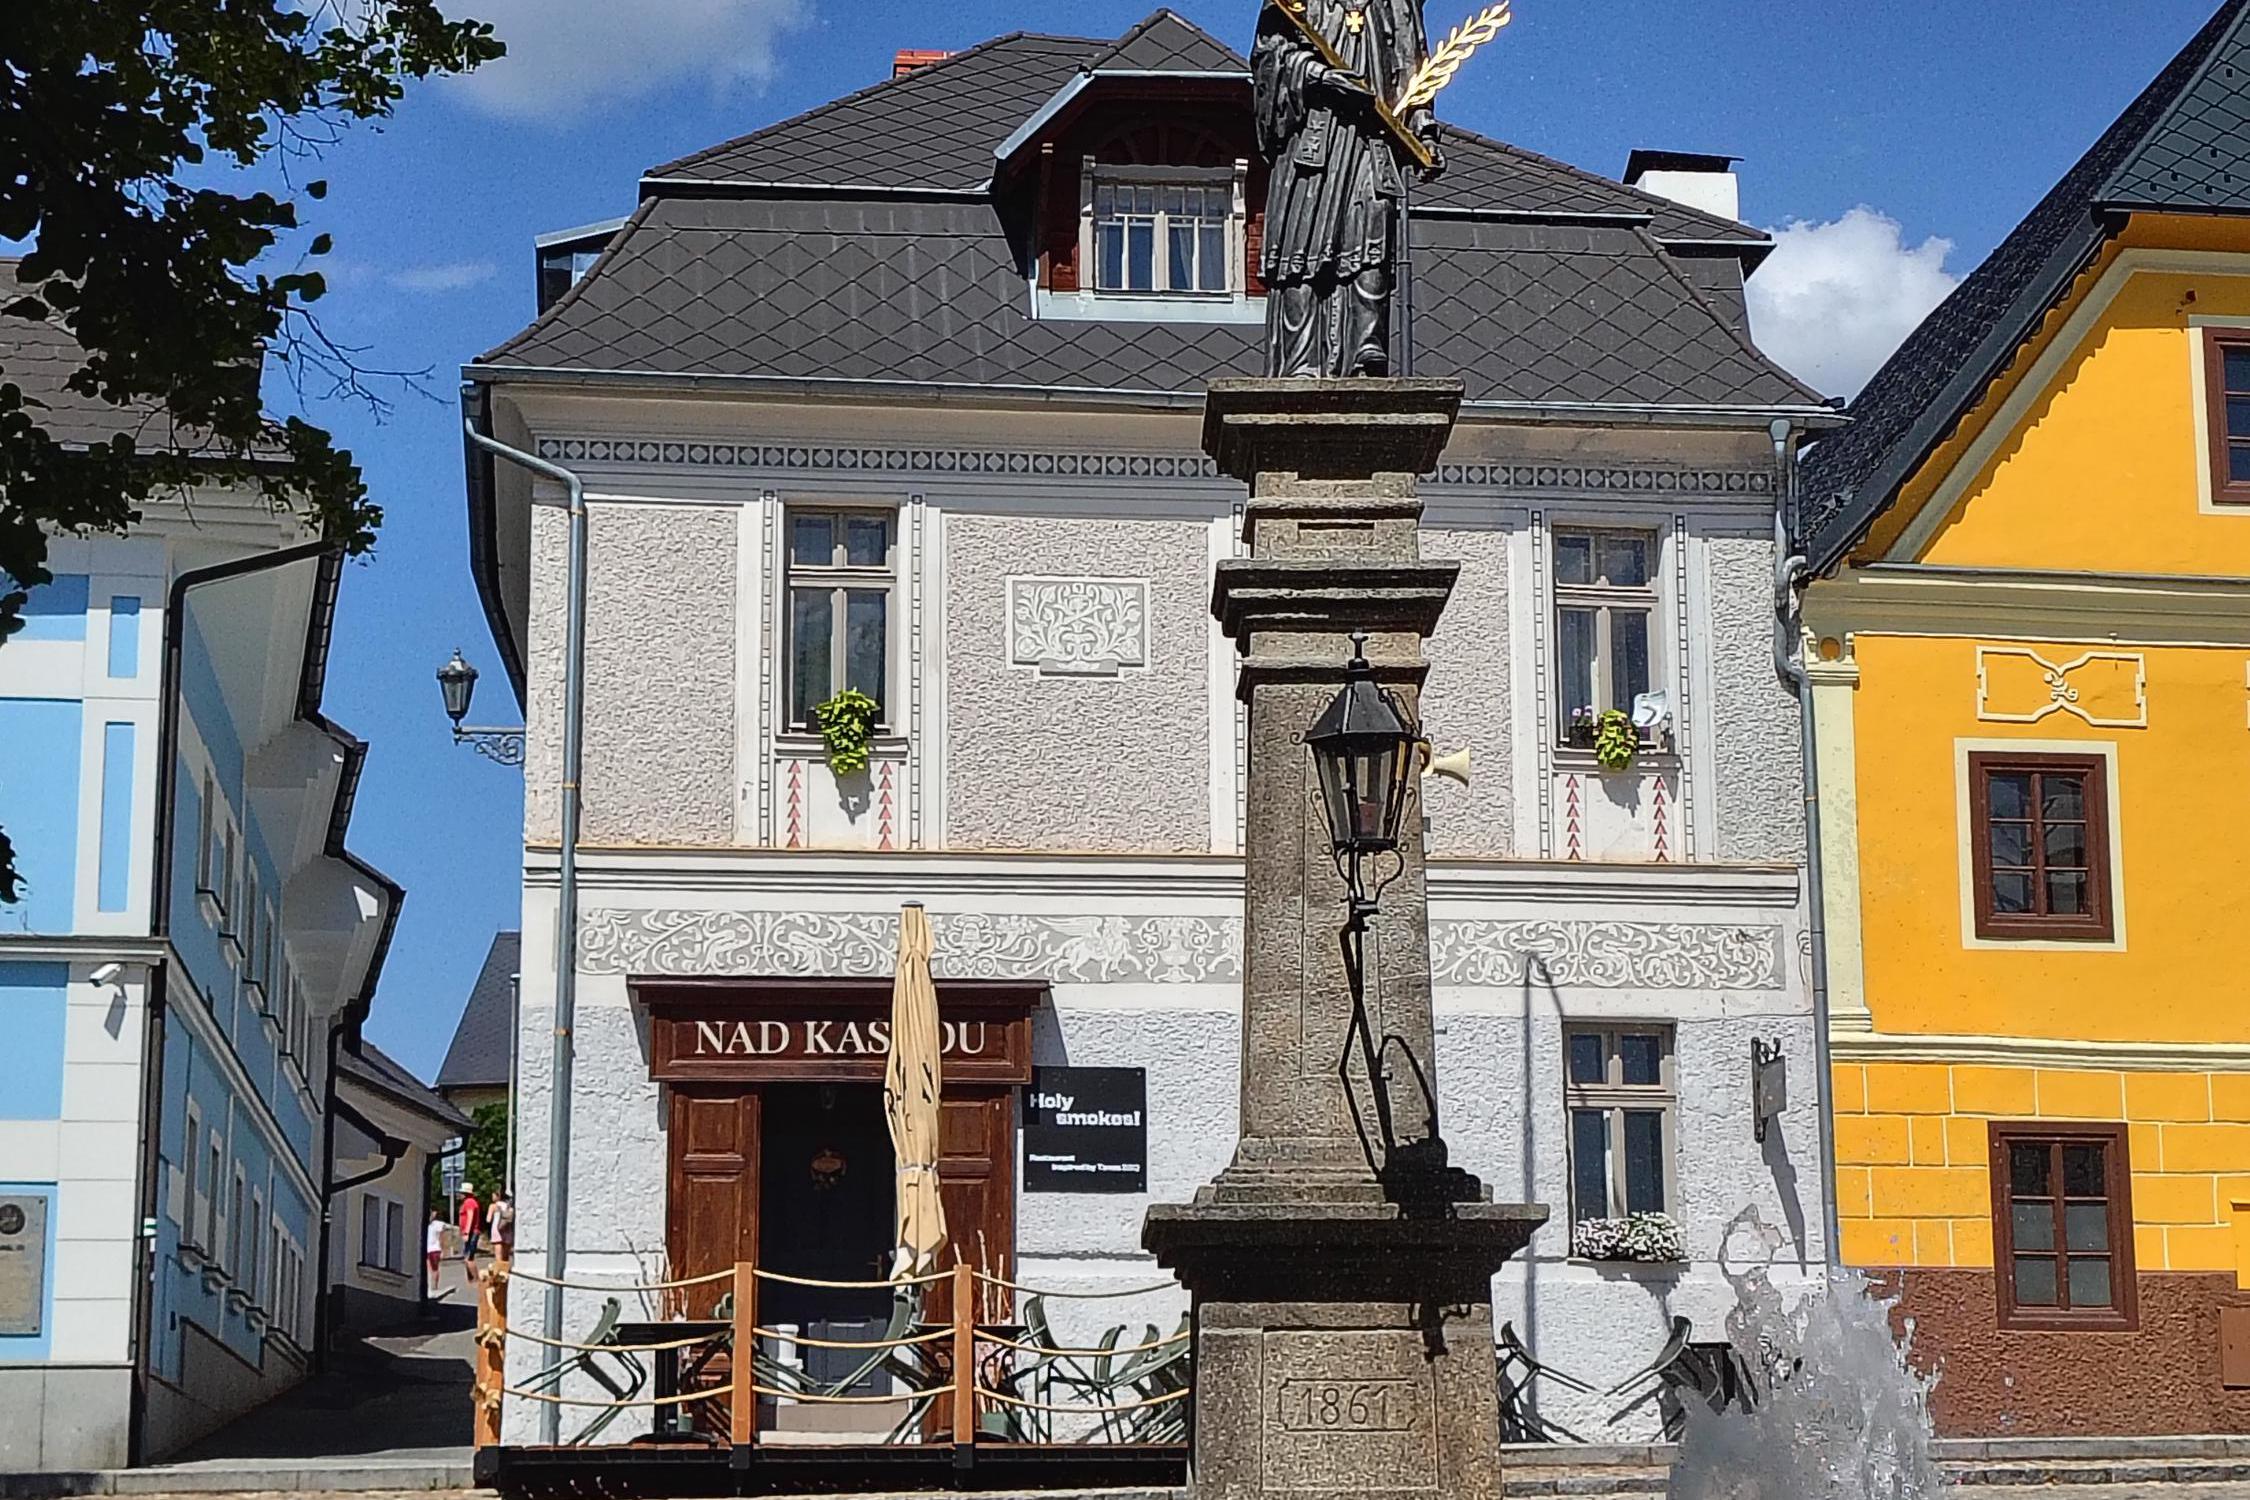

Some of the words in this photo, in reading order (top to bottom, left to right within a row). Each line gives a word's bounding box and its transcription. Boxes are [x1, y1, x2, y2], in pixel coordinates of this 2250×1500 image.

[694, 1020, 790, 1054] NAD
[803, 1018, 987, 1055] KAŠU
[1029, 1092, 1075, 1112] Holy
[1300, 1386, 1390, 1426] 1861
